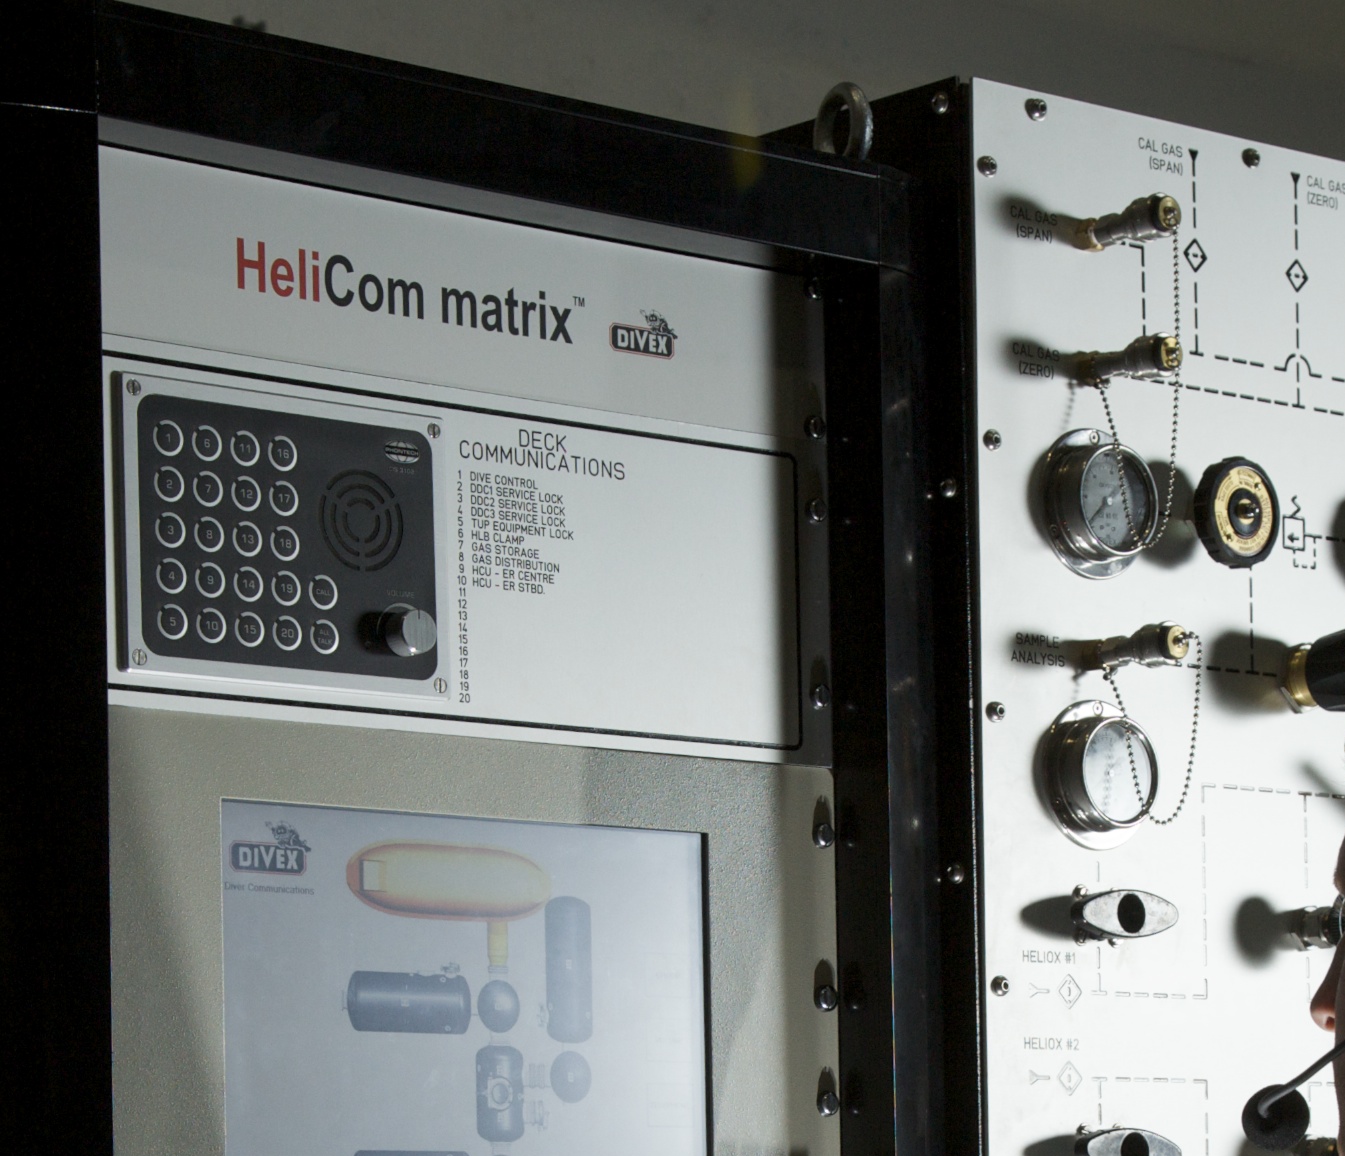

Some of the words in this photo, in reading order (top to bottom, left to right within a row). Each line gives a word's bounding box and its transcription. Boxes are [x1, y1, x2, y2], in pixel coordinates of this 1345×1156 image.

[1138, 137, 1159, 153] CAL
[1161, 142, 1183, 158] GAS
[1149, 156, 1184, 177] (SPAN)
[1306, 175, 1326, 190] CAL
[1307, 191, 1339, 211] (ZERO)
[1010, 205, 1031, 221] CAL
[1035, 210, 1058, 226] GAS
[1016, 223, 1053, 244] (SPAN)
[236, 237, 425, 320] HeliCom
[441, 287, 574, 345] matrix
[616, 327, 669, 355] DIVEX
[1012, 342, 1034, 359] CAL
[1037, 346, 1061, 363] GAS
[1018, 360, 1055, 380] (ZERO)
[239, 444, 251, 453] 11
[519, 429, 568, 454] DECK
[277, 449, 290, 459] 16
[459, 440, 626, 481] COMMUNICATIONS
[470, 471, 492, 484] DIVE
[495, 475, 539, 491] CONTROL
[240, 489, 254, 499] 12
[278, 494, 291, 504] 17
[470, 483, 493, 495] DDC1
[496, 486, 536, 502] SERVICE
[539, 492, 564, 505] LOCK
[470, 495, 496, 507] DDC2
[498, 499, 538, 513] SERVICE
[541, 504, 566, 517] LOCK
[471, 507, 496, 519] DDC3
[498, 510, 539, 525] SERVICE
[541, 516, 566, 528] LOCK
[471, 518, 490, 530] TUP
[493, 521, 547, 538] EQUIPMENT
[550, 529, 575, 541] LOCK
[241, 534, 255, 545] 13
[279, 539, 292, 549] 18
[471, 530, 490, 542] HLB
[493, 533, 525, 546] CLAMP
[472, 542, 492, 554] GAS
[495, 545, 540, 560] STORAGE
[472, 554, 492, 566] GAS
[495, 557, 561, 574] DISTRIBUTION
[472, 565, 492, 577] HCU
[503, 569, 515, 580] ER
[518, 571, 555, 585] CENTRE
[242, 579, 256, 589] 14
[281, 583, 294, 594] 19
[457, 575, 468, 586] 10
[472, 577, 492, 589] HCU
[503, 581, 516, 592] ER
[518, 582, 546, 595] STBD.
[316, 588, 332, 597] CALL
[387, 590, 415, 599] VOLUME
[459, 588, 467, 598] 11
[458, 599, 468, 610] 12
[458, 611, 468, 621] 13
[205, 621, 219, 631] 10
[244, 625, 257, 635] 15
[319, 629, 331, 637] ALL
[458, 622, 468, 633] 14
[281, 629, 295, 639] 20
[317, 637, 333, 646] TALK
[459, 634, 469, 645] 15
[1016, 632, 1060, 649] SAMPLE
[459, 646, 469, 657] 16
[1011, 649, 1066, 668] ANALYSIS
[459, 658, 469, 668] 17
[460, 669, 469, 680] 18
[460, 681, 470, 692] 19
[459, 693, 471, 704] 20
[238, 846, 299, 871] DIVEX
[224, 881, 245, 892] Diver
[247, 882, 315, 896] Communications
[1022, 950, 1061, 964] HELIOX
[1065, 952, 1076, 965] #1
[1024, 1037, 1063, 1051] HELIOX
[1066, 1038, 1080, 1051] #2
